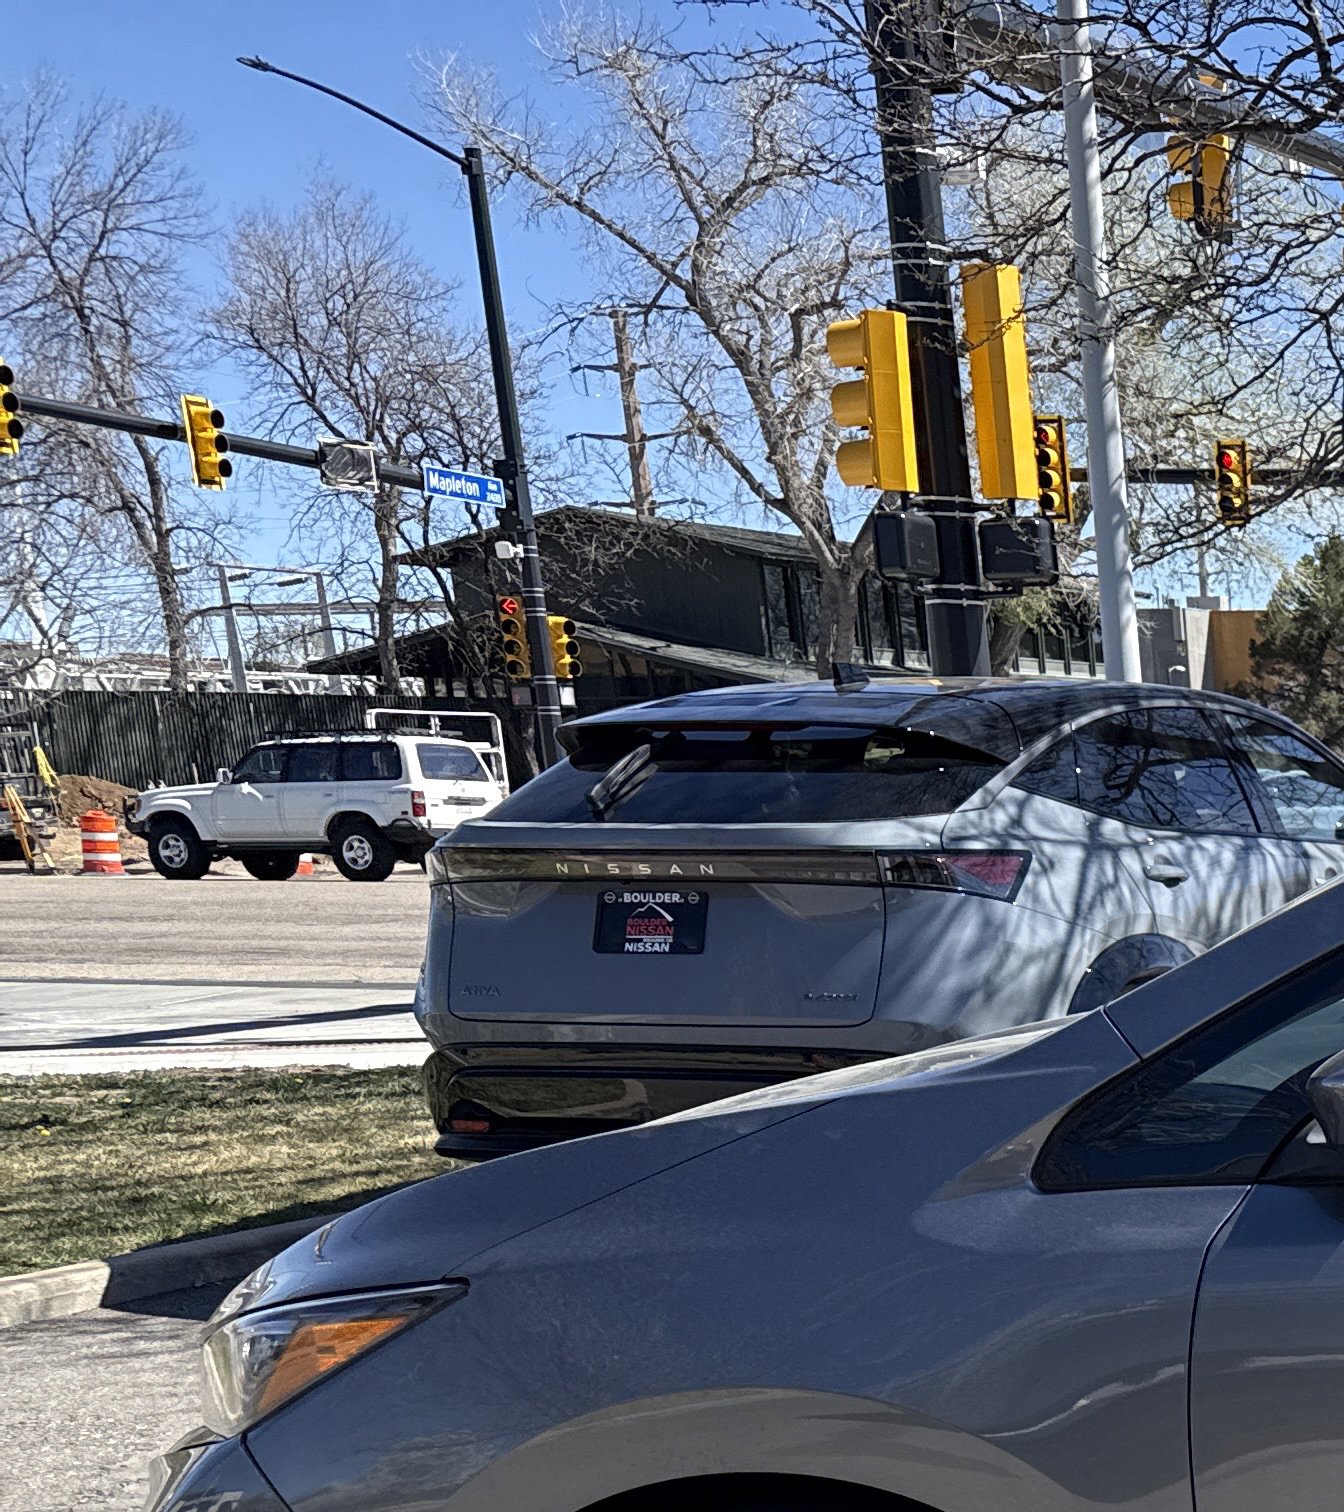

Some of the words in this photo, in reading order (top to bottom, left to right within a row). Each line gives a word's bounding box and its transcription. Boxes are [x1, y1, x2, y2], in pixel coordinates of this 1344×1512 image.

[429, 470, 481, 497] Mapleton
[556, 863, 714, 876] NISSAN
[623, 892, 681, 903] BOULDER
[625, 926, 674, 935] NISSAN
[624, 942, 670, 952] NISSAN
